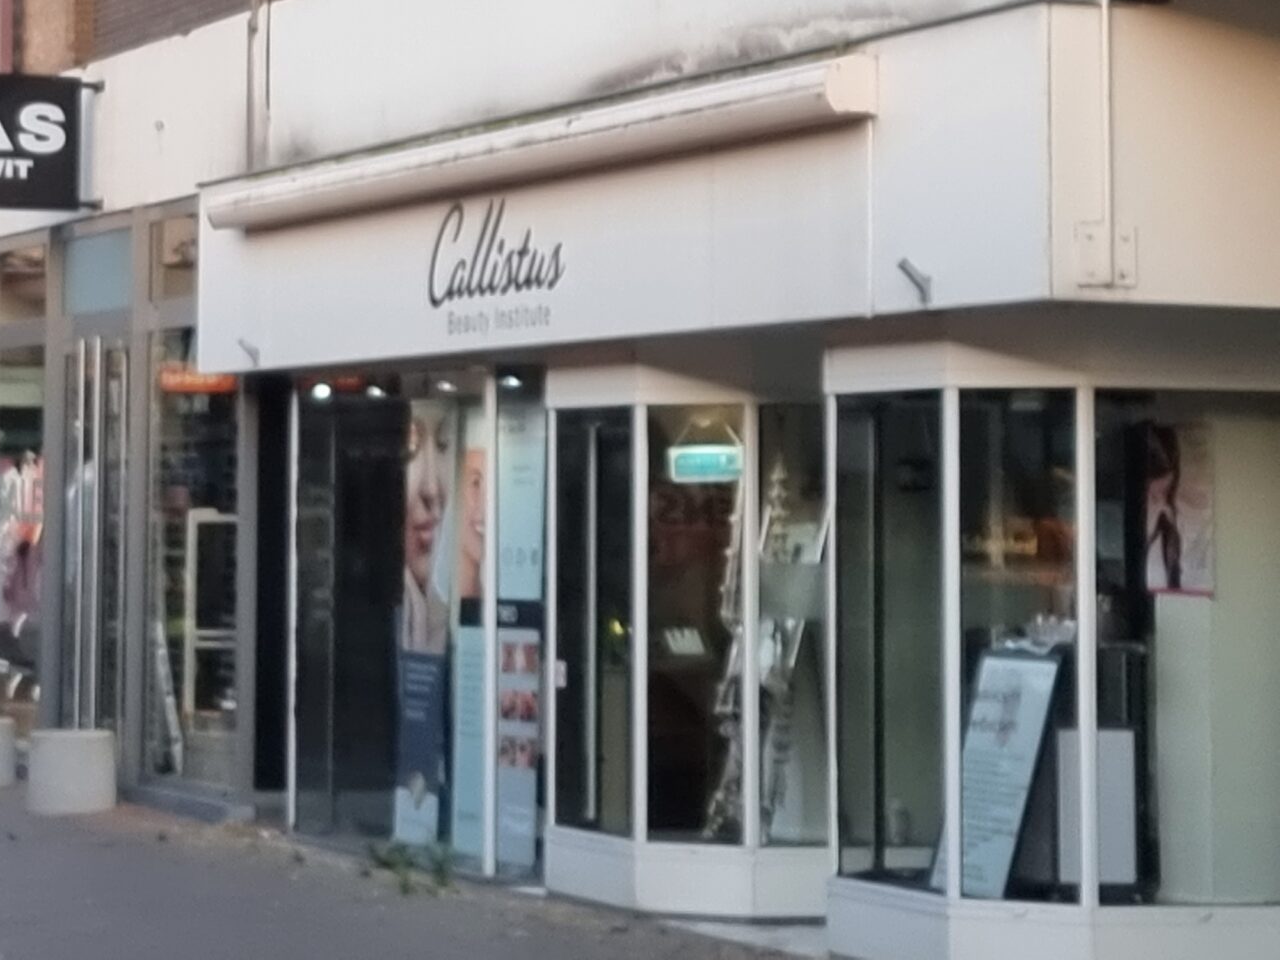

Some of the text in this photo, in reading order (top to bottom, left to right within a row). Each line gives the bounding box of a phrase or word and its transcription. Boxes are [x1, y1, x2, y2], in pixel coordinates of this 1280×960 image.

[427, 196, 566, 309] Callistus
[446, 303, 552, 337] Beauty Institute
